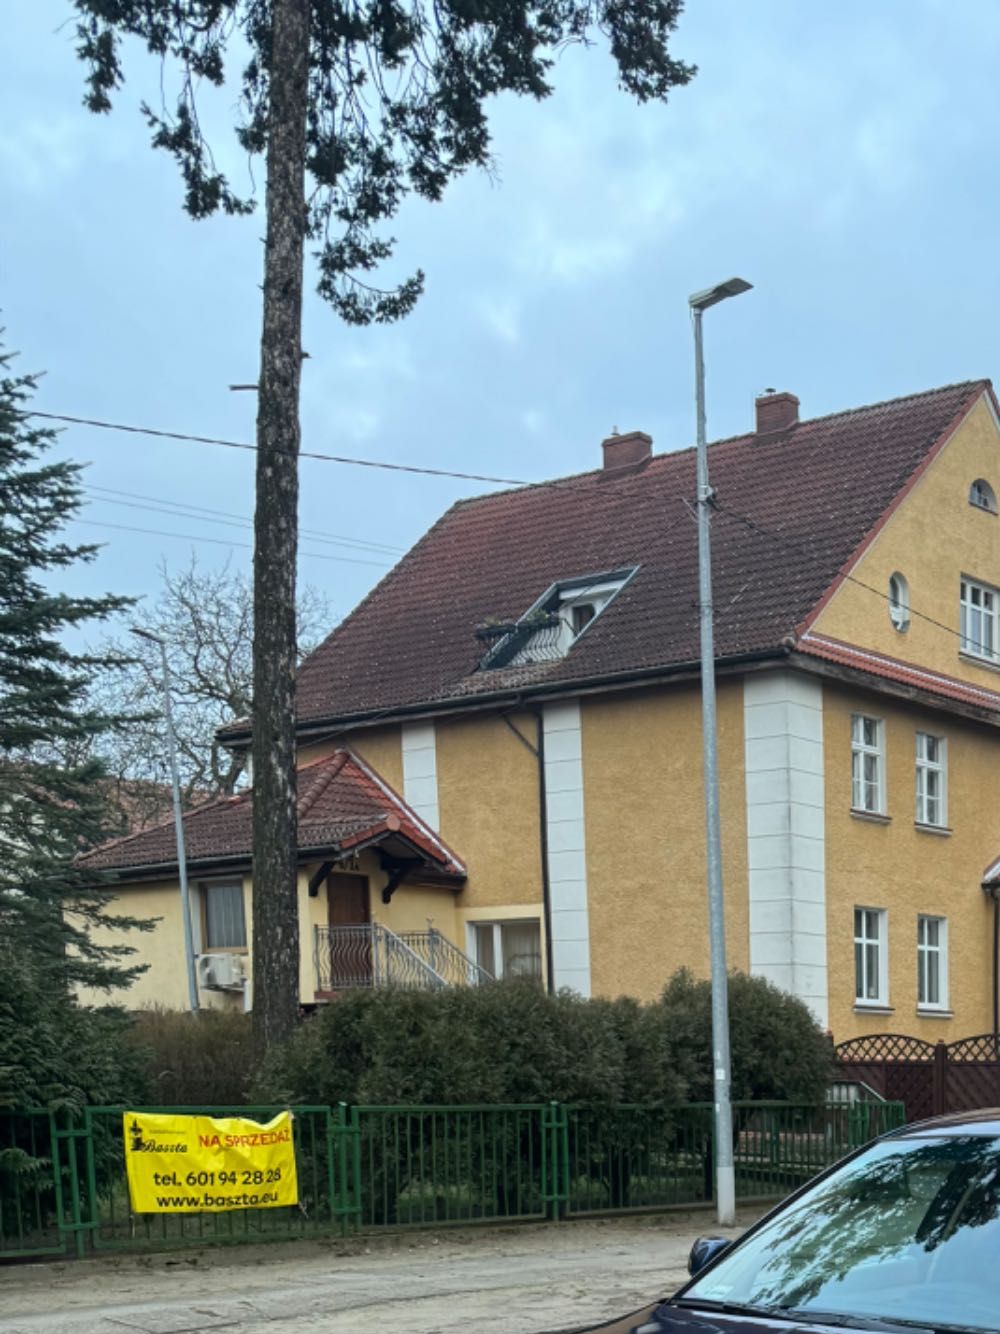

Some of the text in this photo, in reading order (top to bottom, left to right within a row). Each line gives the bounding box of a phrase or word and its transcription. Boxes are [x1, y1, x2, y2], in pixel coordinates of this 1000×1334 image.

[142, 1138, 188, 1153] Baszta
[198, 1127, 291, 1148] NA SPRZEDAŻ
[153, 1171, 182, 1187] tel.
[185, 1170, 215, 1187] 601
[218, 1170, 238, 1186] 94
[241, 1170, 264, 1185] 28
[156, 1192, 279, 1208] www.baszta.eu
